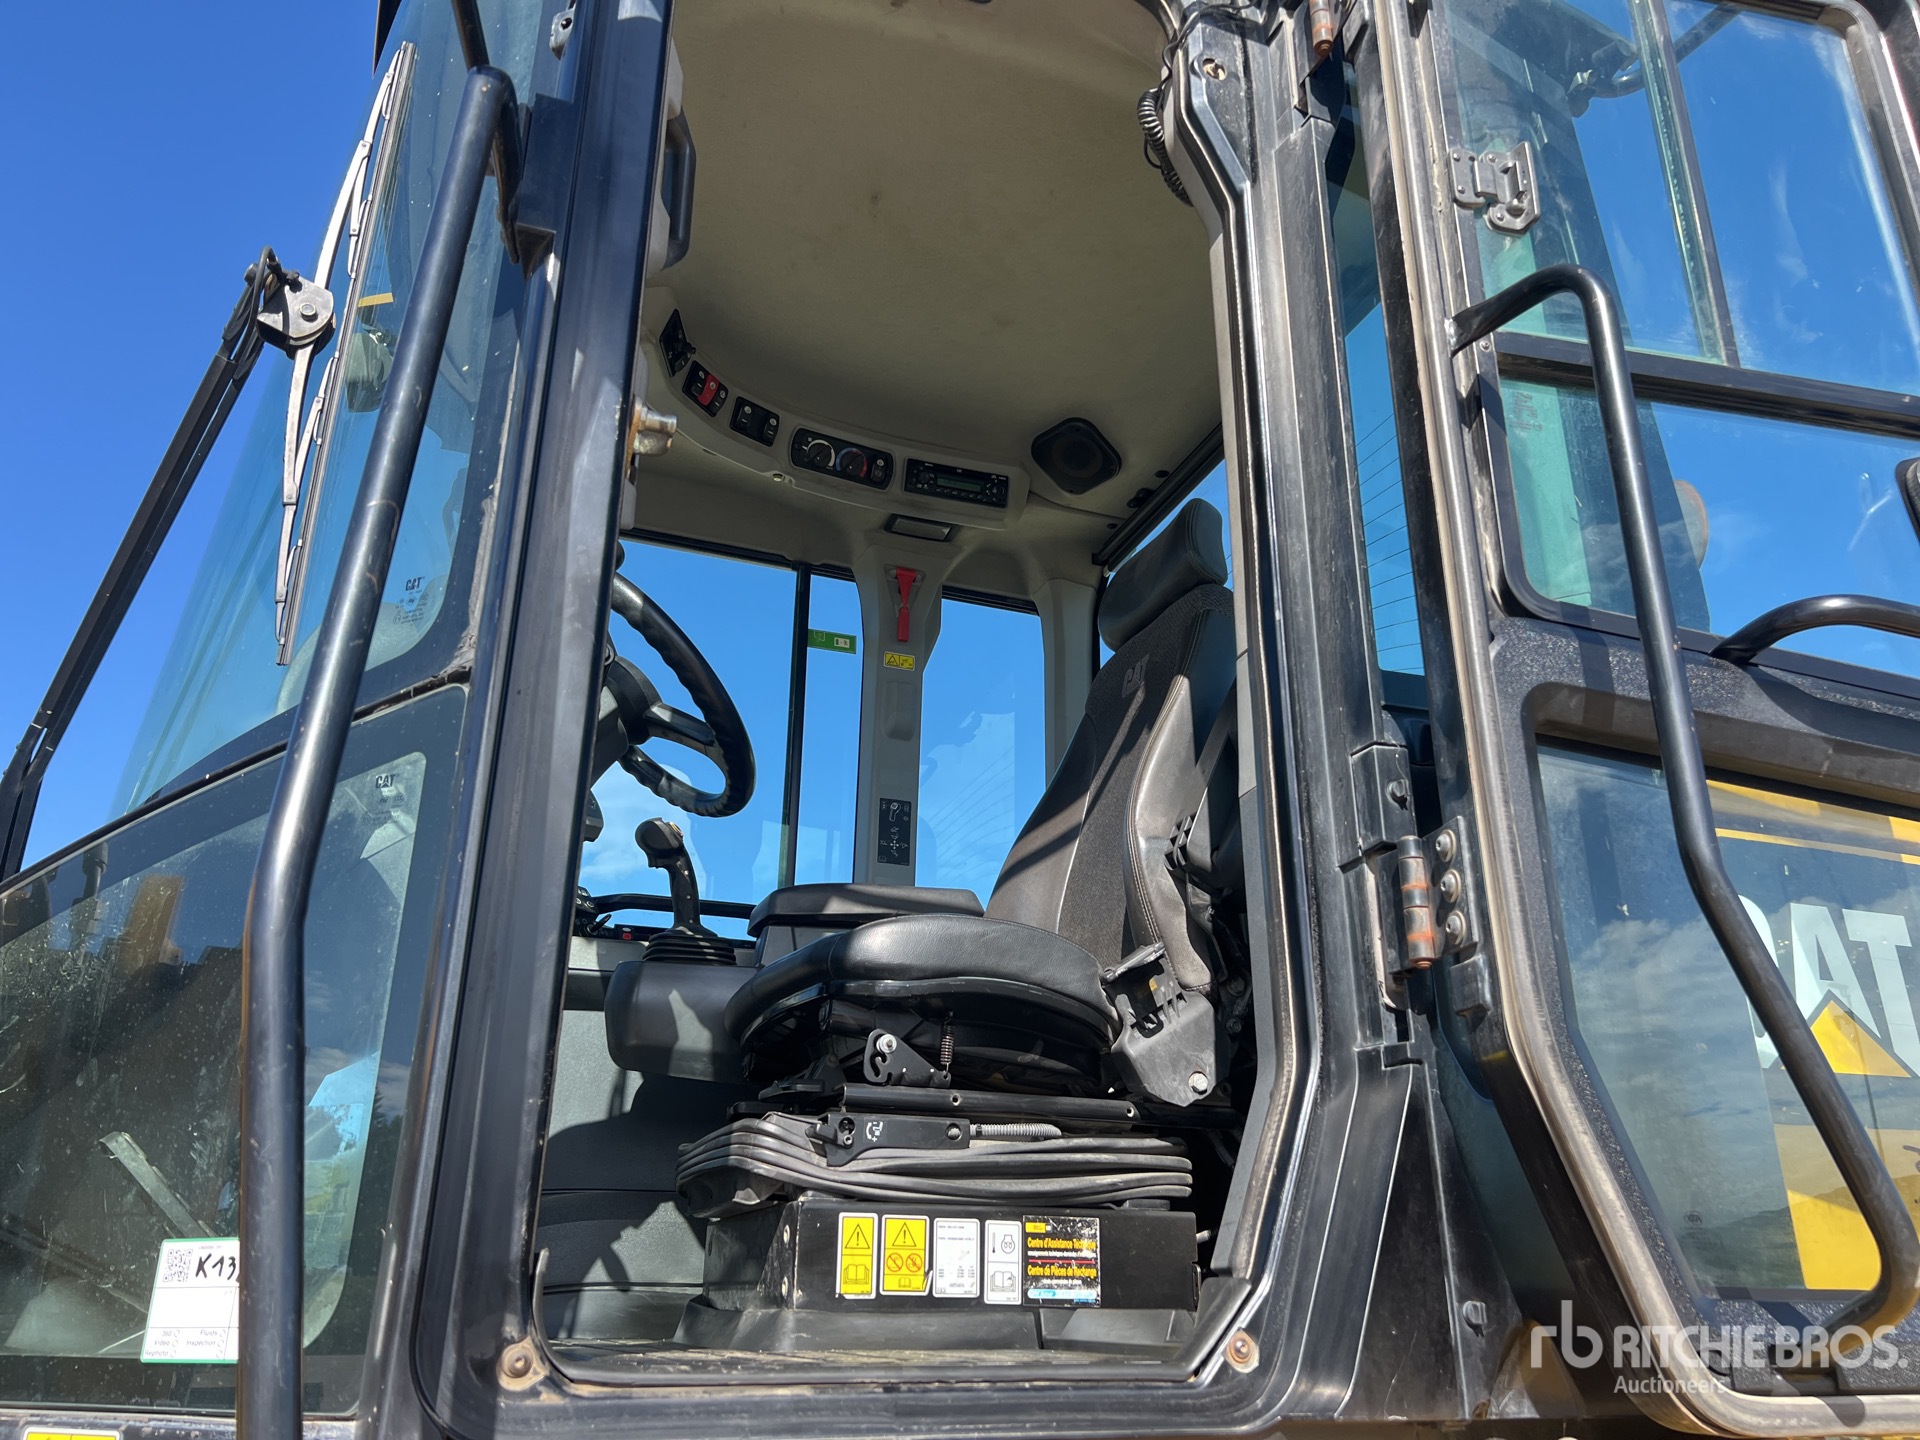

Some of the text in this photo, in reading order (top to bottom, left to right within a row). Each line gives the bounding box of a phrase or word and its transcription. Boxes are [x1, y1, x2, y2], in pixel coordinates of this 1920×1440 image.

[405, 576, 422, 591] CAT
[375, 774, 395, 789] CAT
[200, 1329, 218, 1337] Fluids
[154, 1339, 216, 1347] Video Inspection
